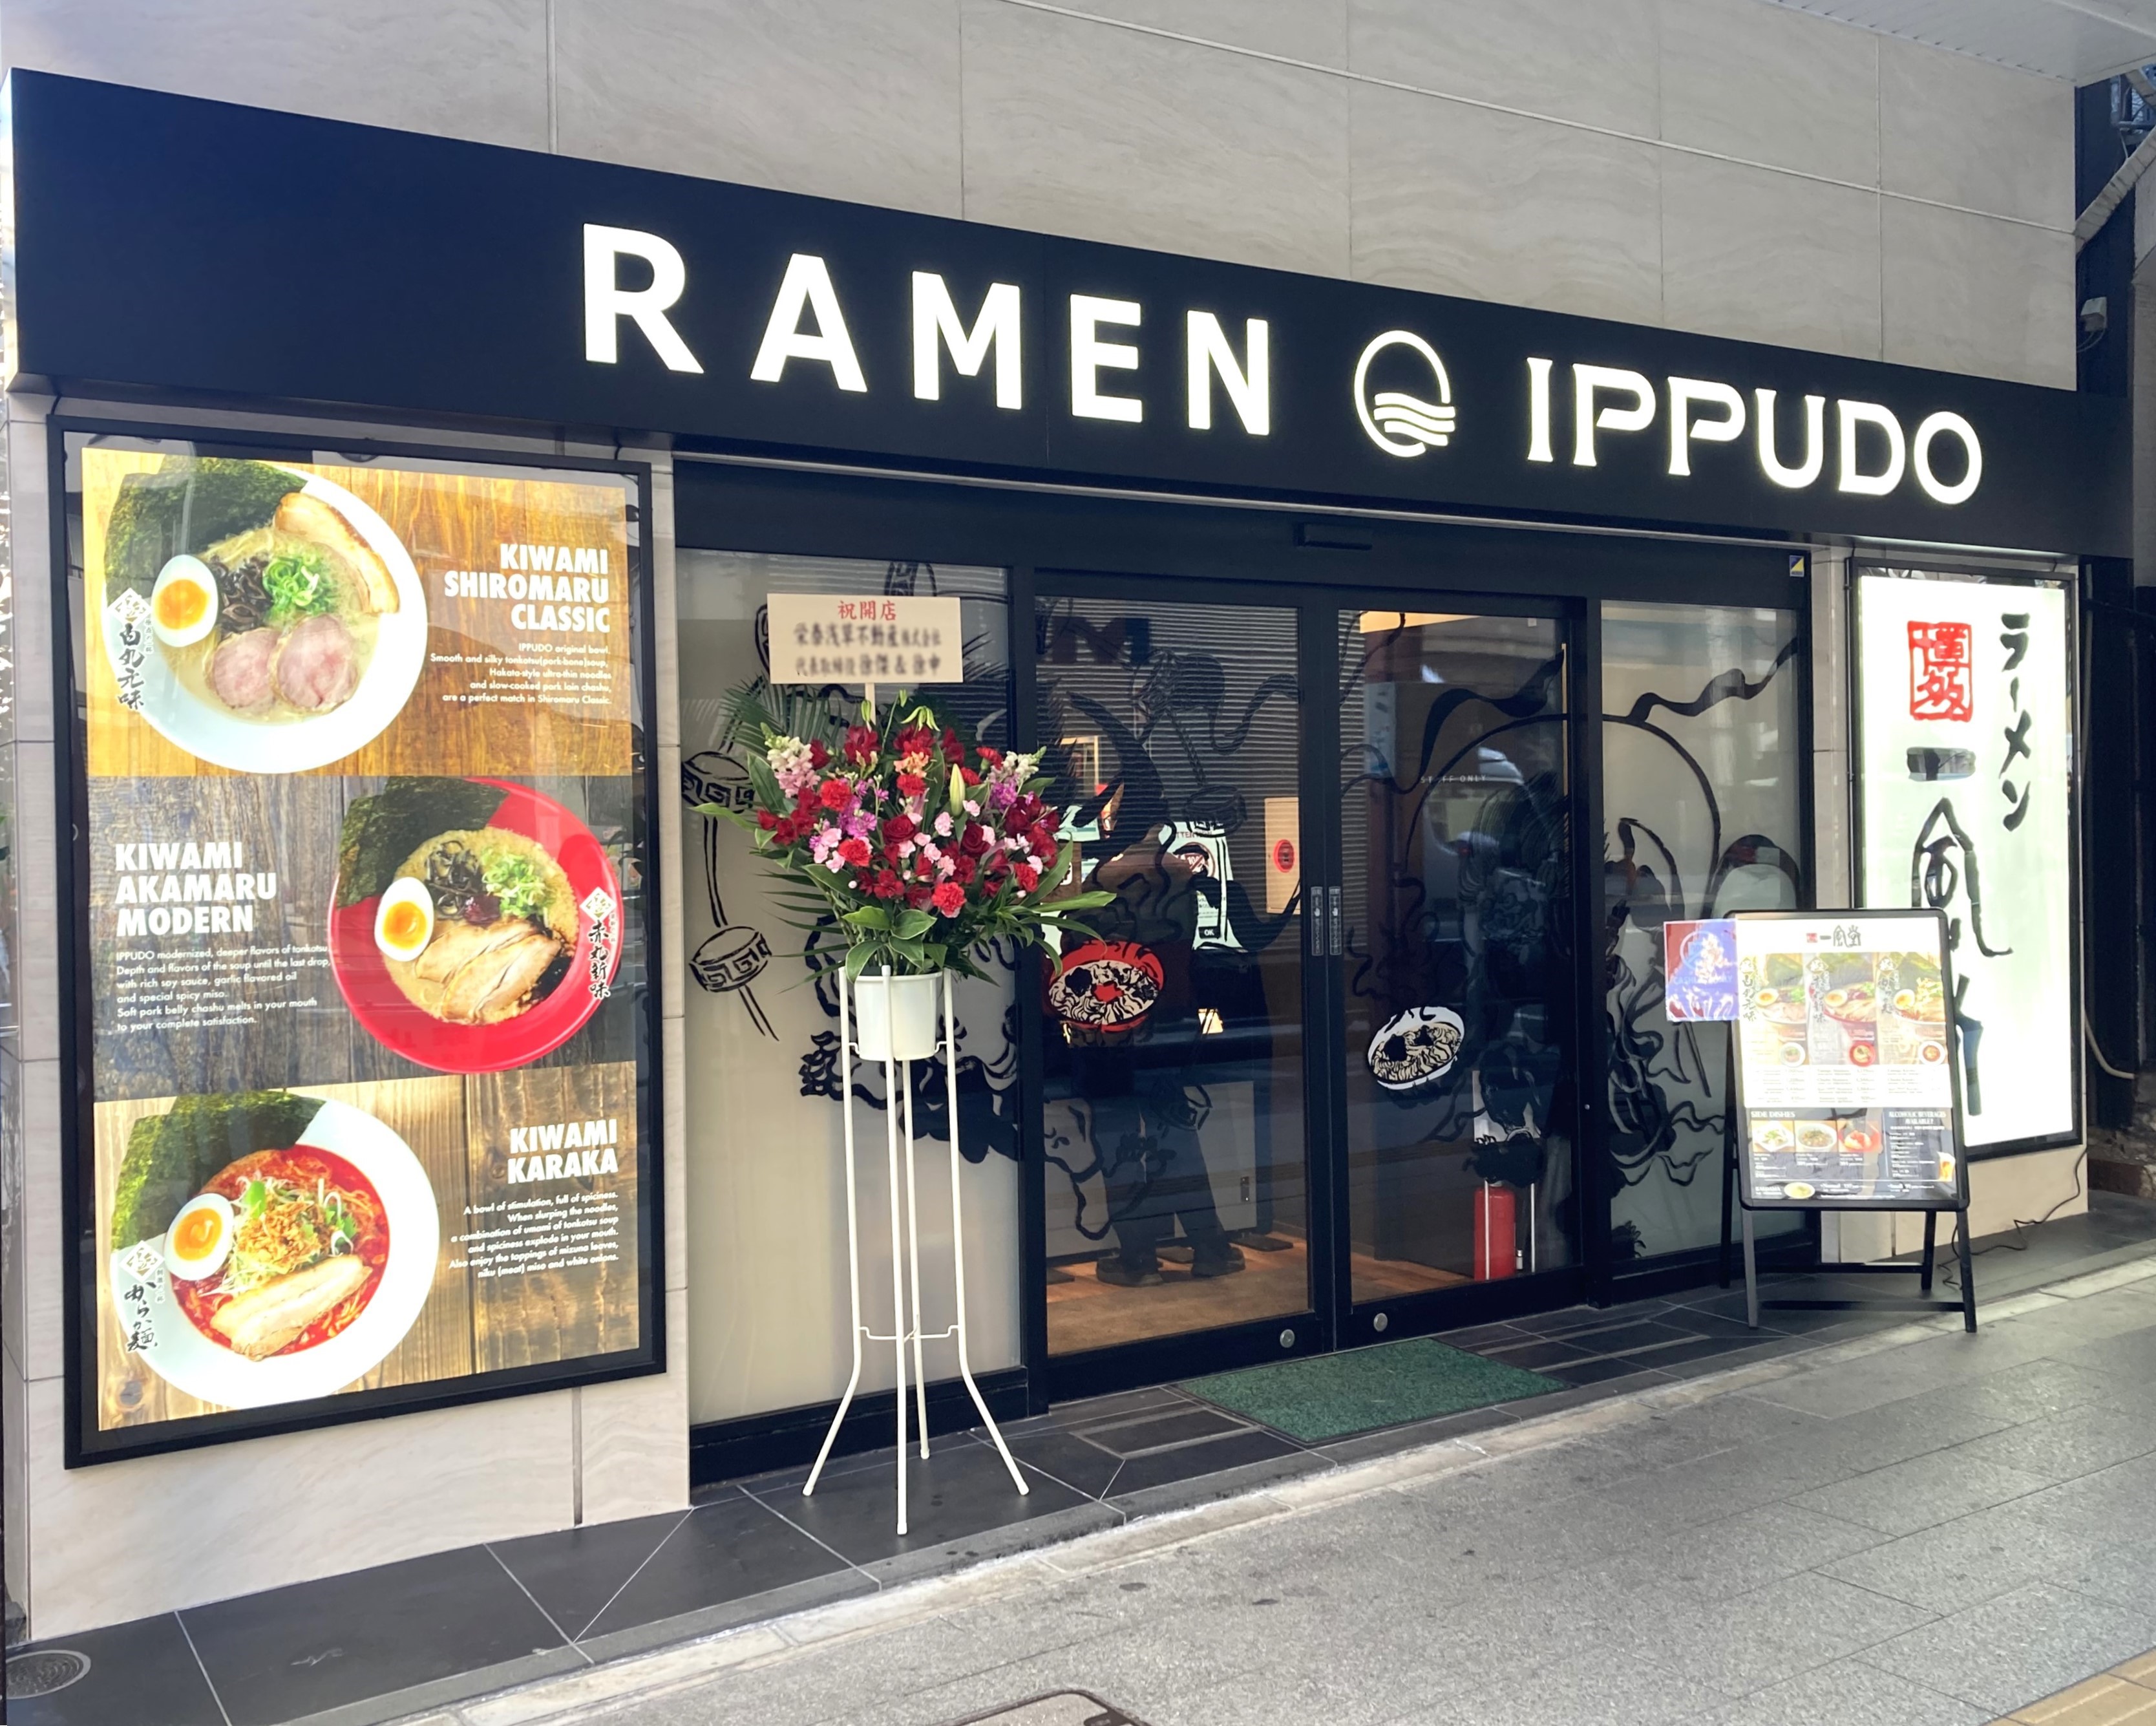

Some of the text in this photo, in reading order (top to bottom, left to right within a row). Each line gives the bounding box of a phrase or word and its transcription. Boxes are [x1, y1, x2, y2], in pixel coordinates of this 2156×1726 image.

[584, 223, 1983, 505] RAMEN IPPUDO
[500, 544, 608, 574] KIWAMI
[445, 571, 609, 603] SHIROMARU
[511, 604, 610, 633] CLASSIC
[838, 600, 896, 621] 祝開店
[430, 654, 463, 662] Smooth
[485, 655, 503, 665] silky
[519, 643, 610, 654] IPPUDO original bowl.
[489, 668, 611, 679] Hakata-style ultra-thin noodles
[470, 680, 487, 688] and
[489, 681, 540, 690] slow-cooked
[543, 682, 562, 692] pork
[469, 694, 498, 703] perfect
[538, 695, 580, 703] Shiromaru
[582, 696, 611, 704] Classic.
[1998, 612, 2032, 832] ラーメン
[116, 842, 242, 871] KIWAMI
[115, 873, 277, 904] AKAMARU
[116, 905, 253, 937] MODERN
[116, 951, 154, 961] IPPUDO
[157, 949, 213, 959] modernized,
[217, 948, 248, 959] deeper
[250, 946, 279, 955] flavors
[281, 945, 290, 954] of
[589, 919, 609, 997] 赤丸新味
[117, 966, 145, 977] Depth
[147, 964, 165, 974] and
[168, 963, 198, 972] flavors
[201, 962, 211, 971] of
[213, 962, 227, 970] the
[229, 962, 251, 972] soup
[253, 959, 271, 968] until
[274, 959, 287, 968] the
[290, 958, 304, 967] last
[116, 972, 297, 989] with rich soy sauce, garlic flavored oil
[117, 990, 227, 1004] and special spicy miso.
[118, 1008, 136, 1017] Soft
[140, 1007, 162, 1018] pork
[165, 1004, 188, 1016] belly
[191, 1003, 224, 1013] chashu
[227, 1001, 251, 1010] melts
[265, 1001, 286, 1011] your
[290, 998, 317, 1007] mouth
[131, 1023, 152, 1033] your
[156, 1019, 199, 1031] complete
[202, 1016, 257, 1026] satisfaction.
[510, 1119, 617, 1154] KIWAMI
[507, 1148, 618, 1184] KARAKA
[463, 1191, 618, 1215] A bowl of stimulation, full of spiciness.
[507, 1203, 618, 1222] When slurping the noodles,
[460, 1230, 511, 1241] combination
[513, 1226, 522, 1235] of
[524, 1223, 551, 1233] umami
[553, 1221, 562, 1230] of
[564, 1219, 597, 1228] tonkotsu
[600, 1217, 618, 1226] soup
[469, 1243, 485, 1253] and
[487, 1239, 523, 1252] spiciness
[525, 1235, 559, 1247] explode
[571, 1233, 589, 1242] your
[591, 1228, 618, 1237] mouth.
[449, 1241, 618, 1269] Also enjoy the toppings of mizuna leaves,
[478, 1253, 618, 1278] niku (meat) miso and white onions.
